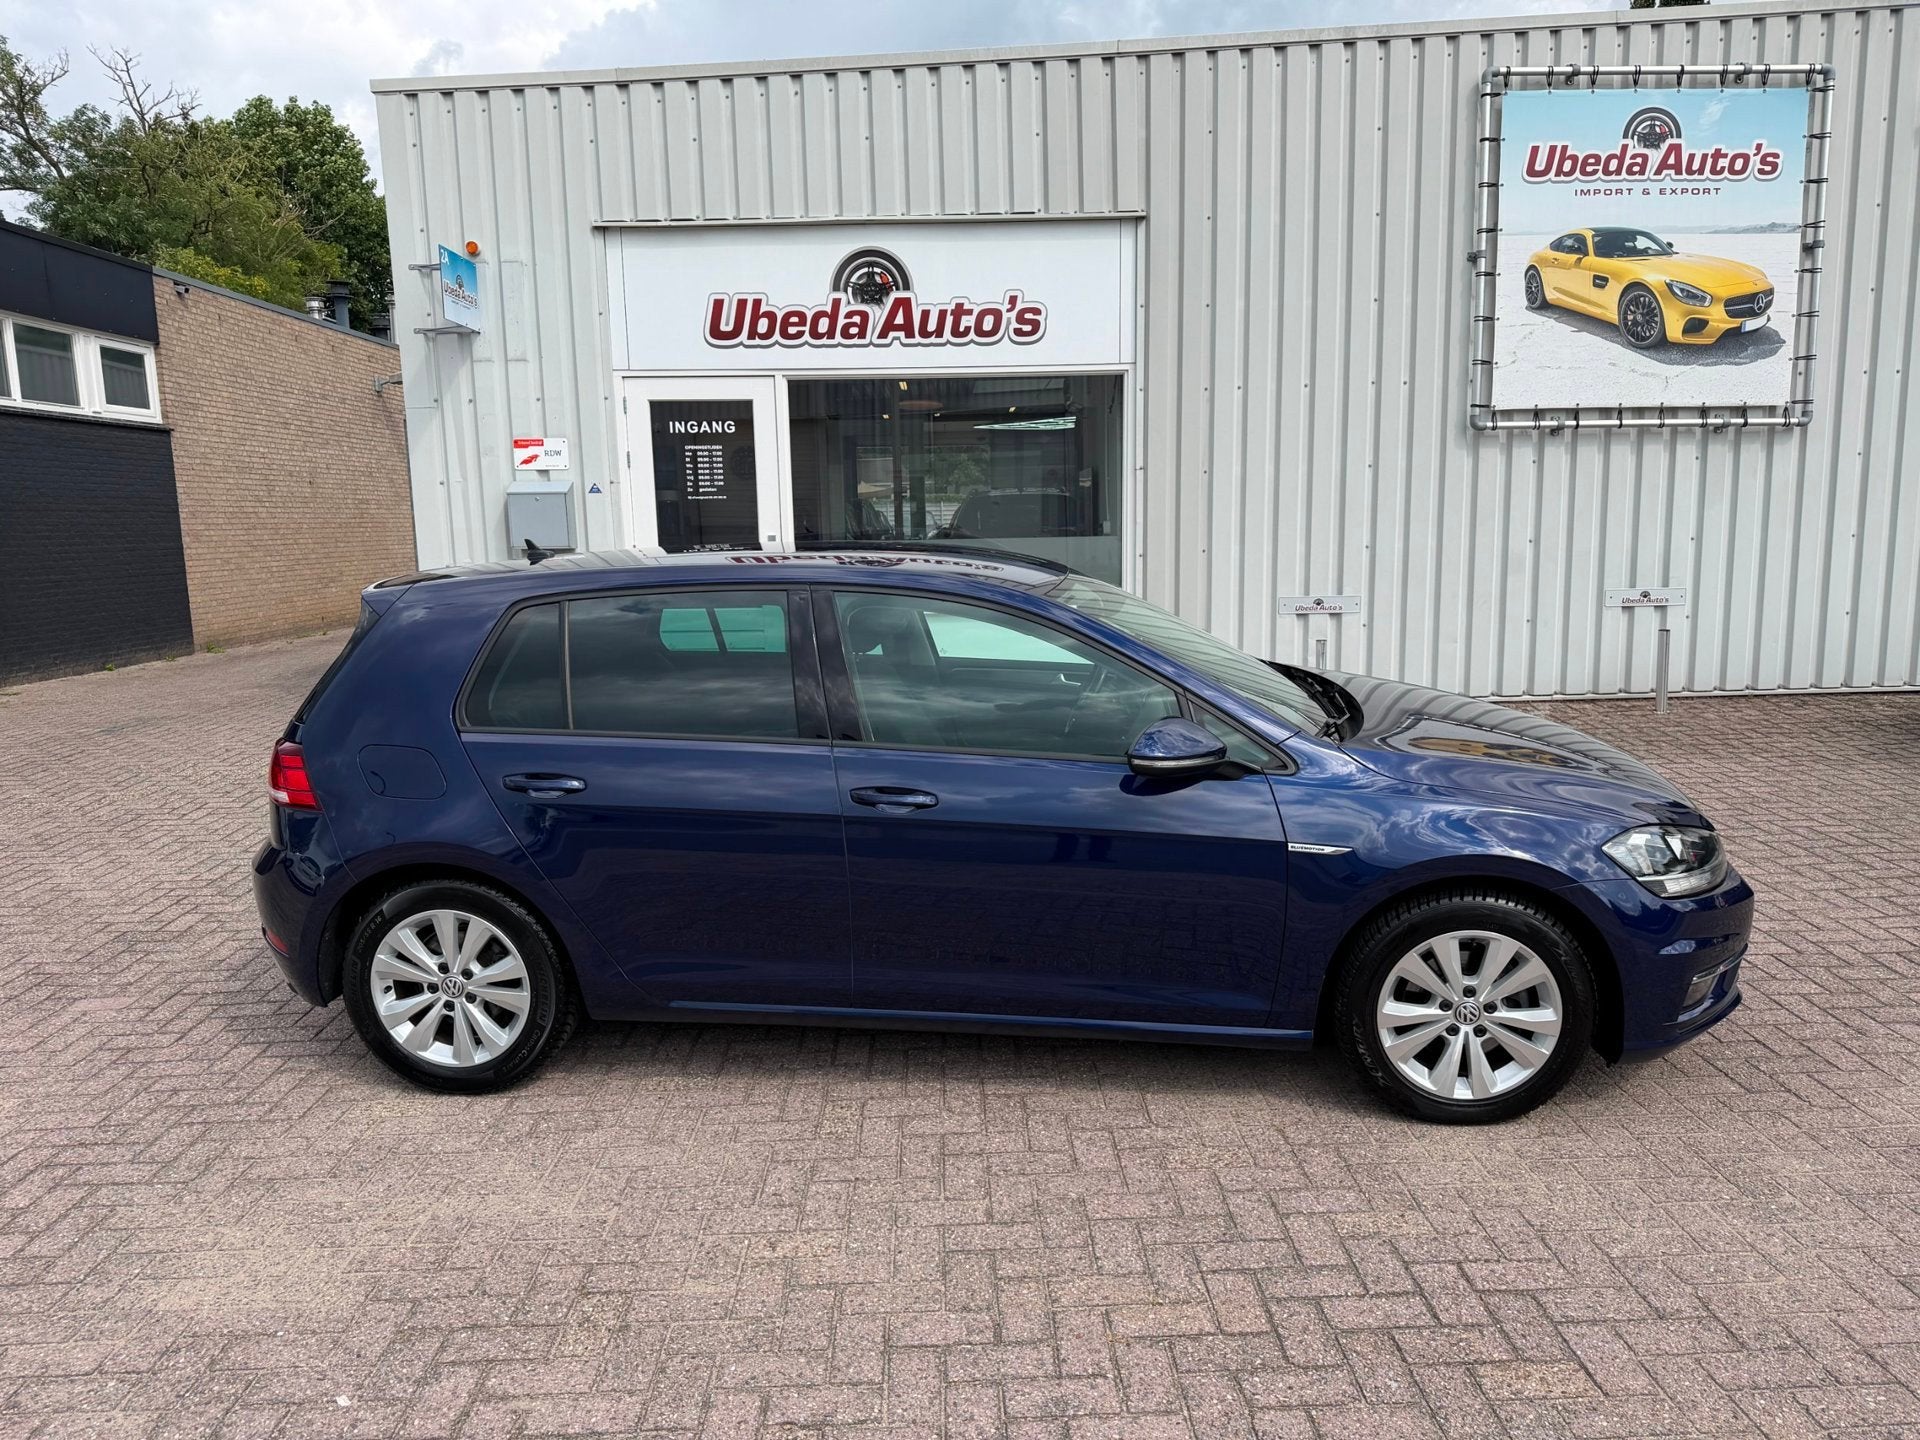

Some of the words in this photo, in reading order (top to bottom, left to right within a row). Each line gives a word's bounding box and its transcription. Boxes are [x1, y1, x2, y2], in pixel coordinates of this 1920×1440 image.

[1525, 144, 1649, 178] Ubeda
[1653, 143, 1780, 176] Auto's
[1574, 188, 1634, 197] IMPORT
[1641, 187, 1651, 196] &
[1659, 187, 1722, 196] EXPORT
[440, 249, 450, 265] 2A
[708, 297, 871, 341] Ubeda
[876, 294, 1043, 340] Auto's
[669, 421, 736, 433] INGANG
[544, 449, 562, 457] RDW
[1320, 603, 1343, 611] Auto's
